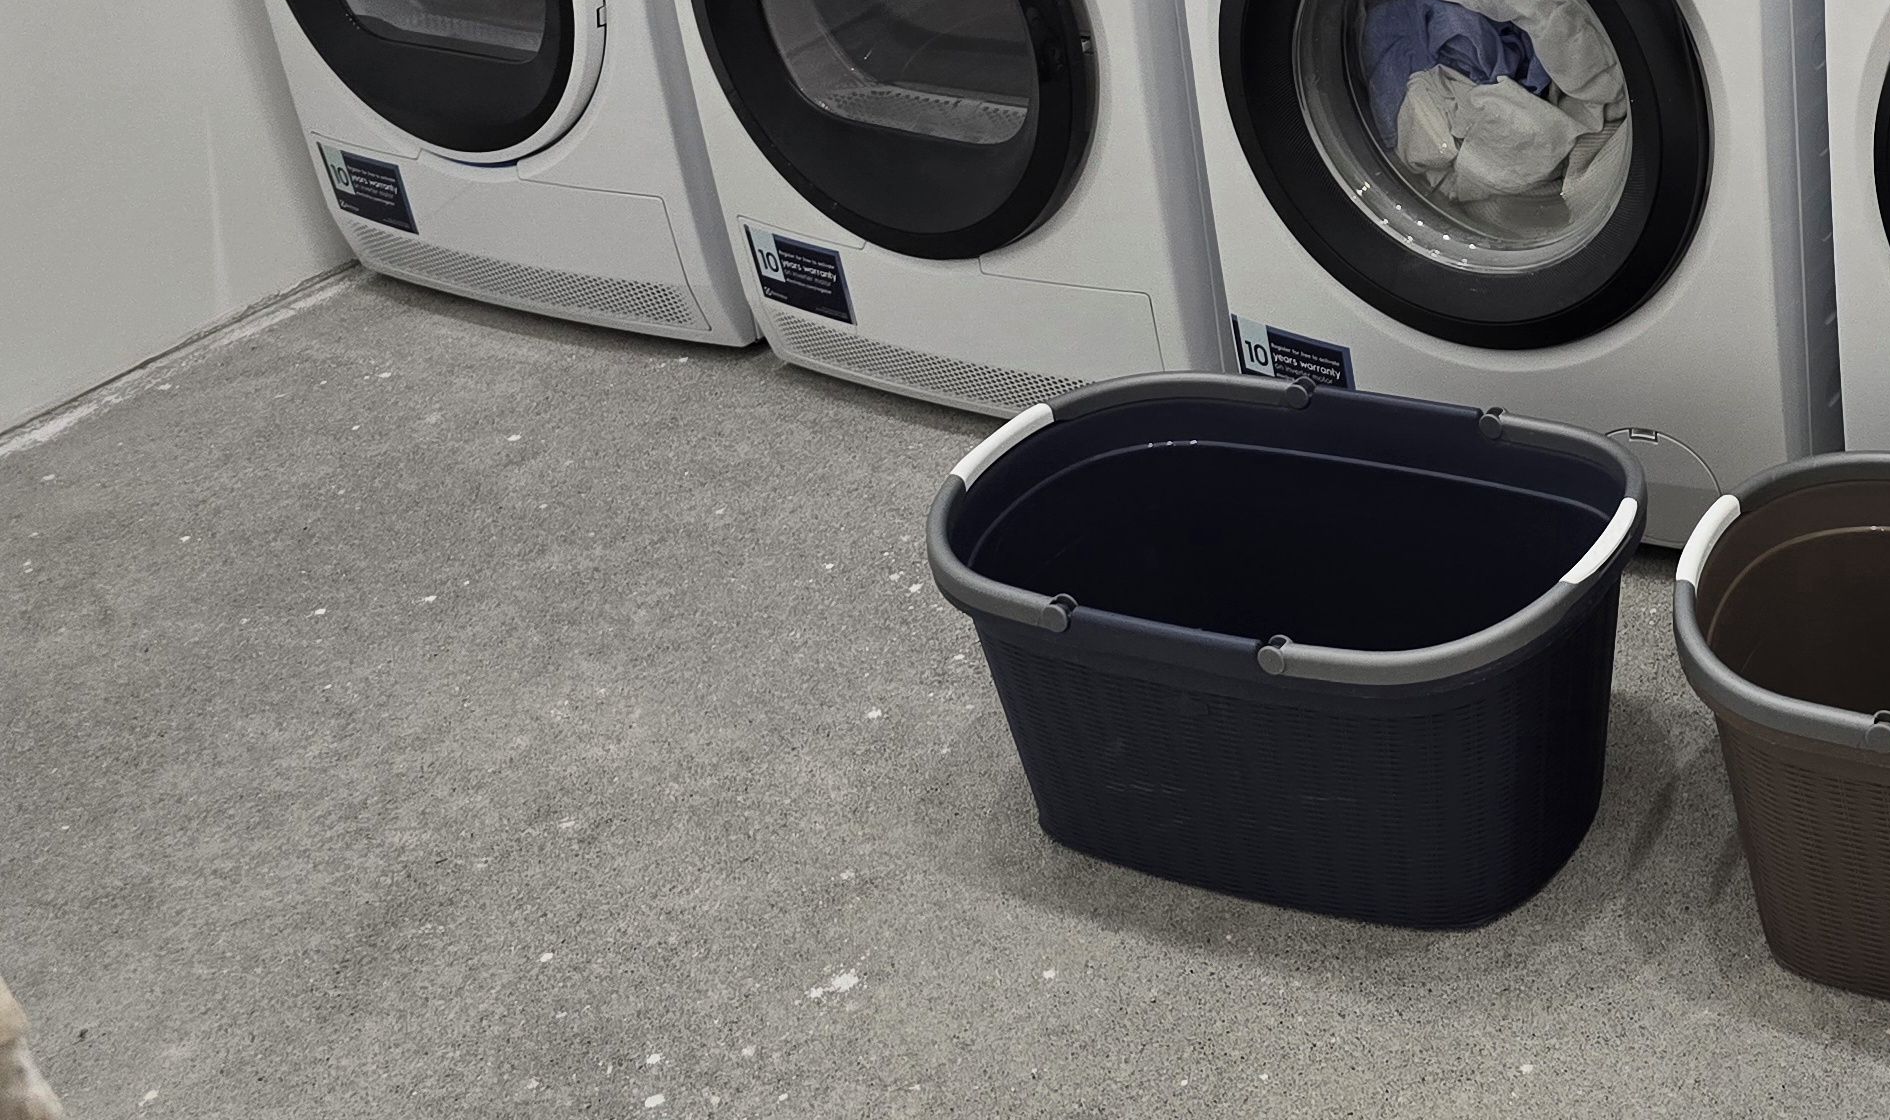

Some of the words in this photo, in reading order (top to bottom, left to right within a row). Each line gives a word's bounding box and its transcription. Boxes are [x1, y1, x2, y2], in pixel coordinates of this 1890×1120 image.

[330, 164, 349, 187] 10
[758, 248, 780, 273] 10
[1244, 340, 1269, 367] 10
[1272, 352, 1298, 366] years
[1299, 360, 1341, 380] warranty
